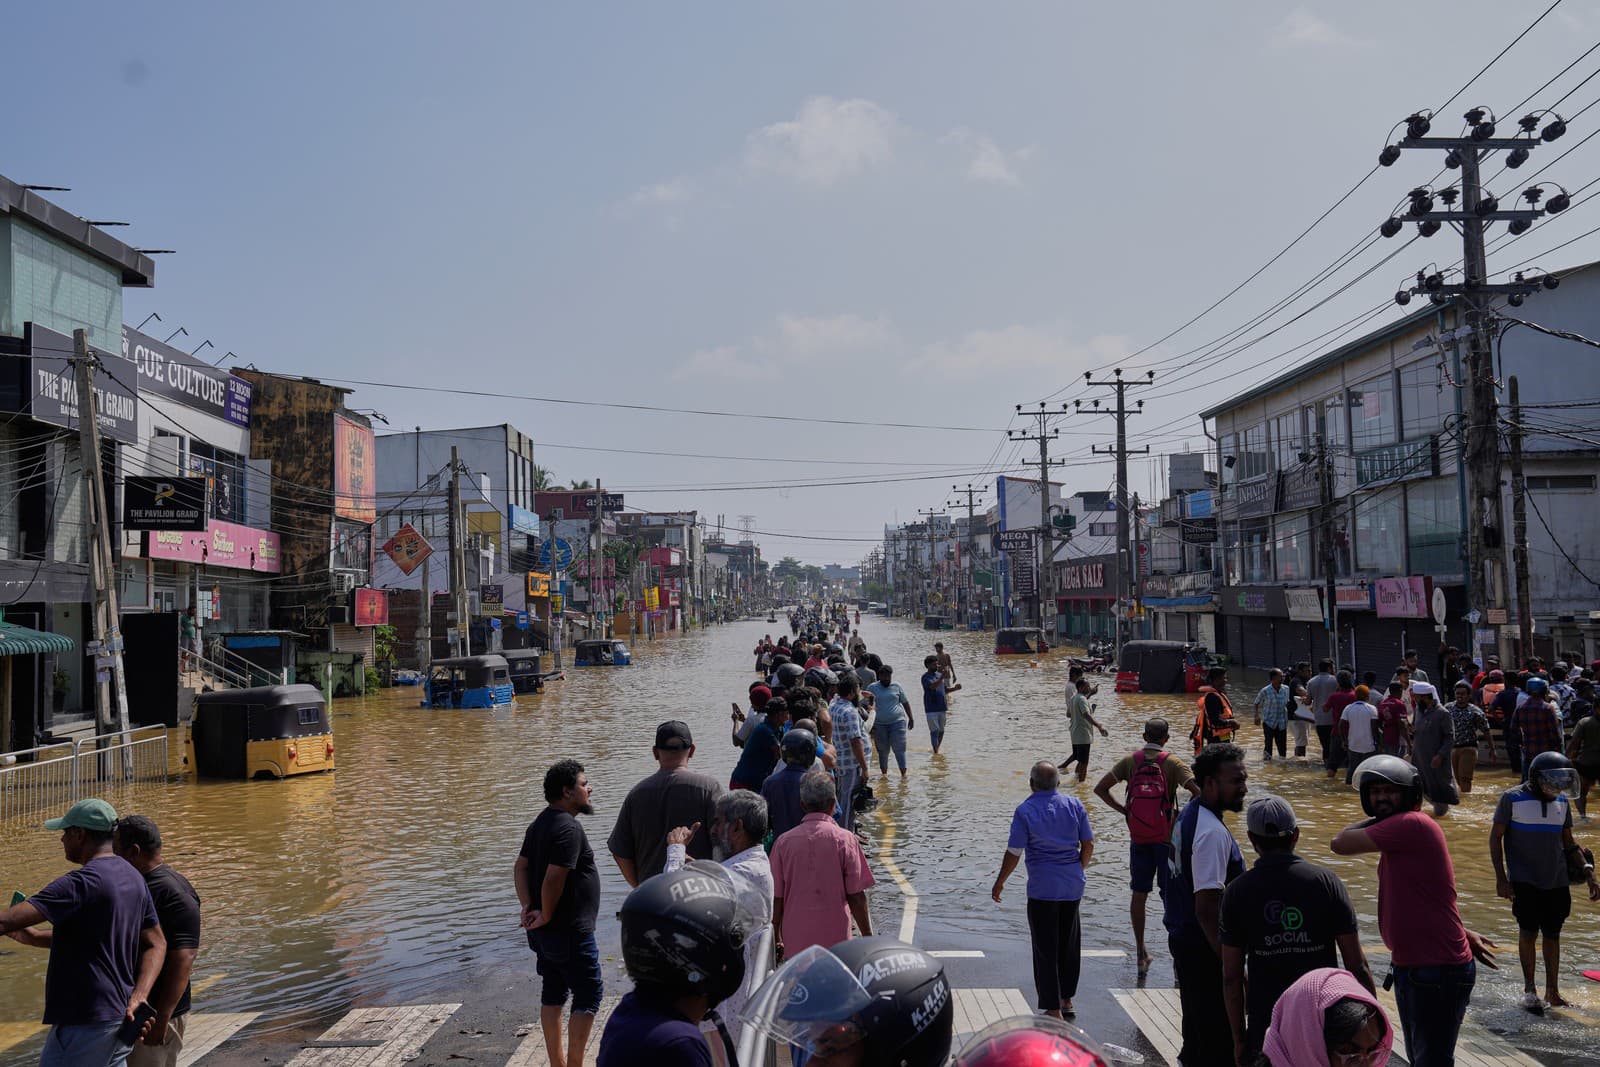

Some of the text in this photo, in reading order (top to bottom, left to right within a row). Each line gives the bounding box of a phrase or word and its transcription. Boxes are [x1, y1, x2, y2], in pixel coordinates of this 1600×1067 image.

[135, 345, 225, 407] CUE CULTURE
[38, 369, 59, 400] THE
[106, 391, 134, 421] GRAND
[130, 509, 199, 519] THE PAVILION GRAND
[1000, 532, 1030, 541] MEGA
[1061, 566, 1081, 590] MEGA
[1082, 563, 1104, 588] SALE
[669, 877, 736, 902] ACTI
[1264, 931, 1312, 946] SOCIAL
